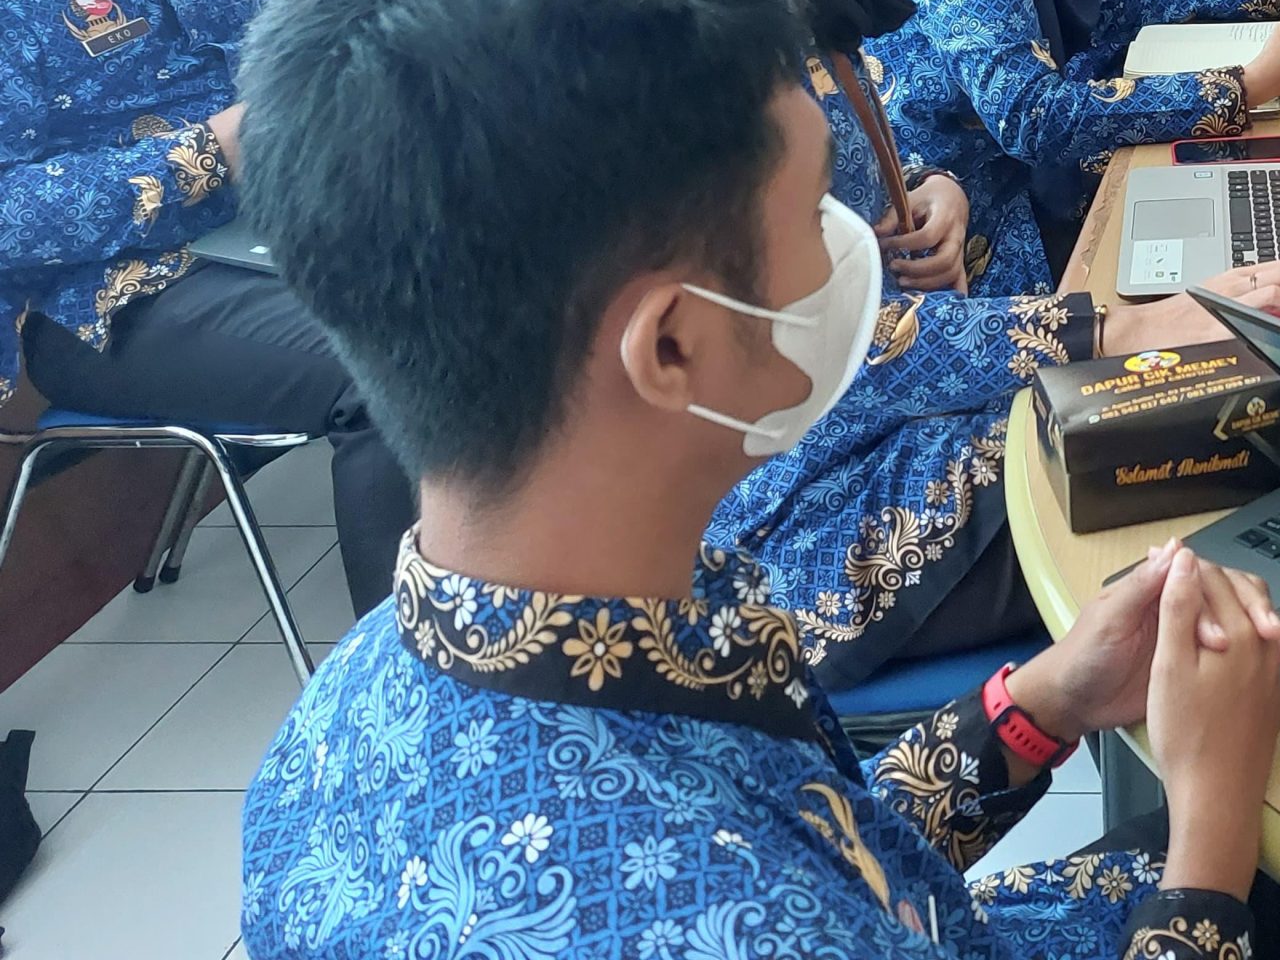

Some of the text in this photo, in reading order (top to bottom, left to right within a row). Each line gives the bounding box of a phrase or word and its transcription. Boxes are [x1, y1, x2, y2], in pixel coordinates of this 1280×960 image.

[107, 28, 131, 43] EKO
[1080, 374, 1140, 396] DAPUR
[1143, 367, 1171, 382] CIK
[1175, 356, 1238, 375] MEMEY
[1115, 448, 1250, 486] Selamat Menikmati
